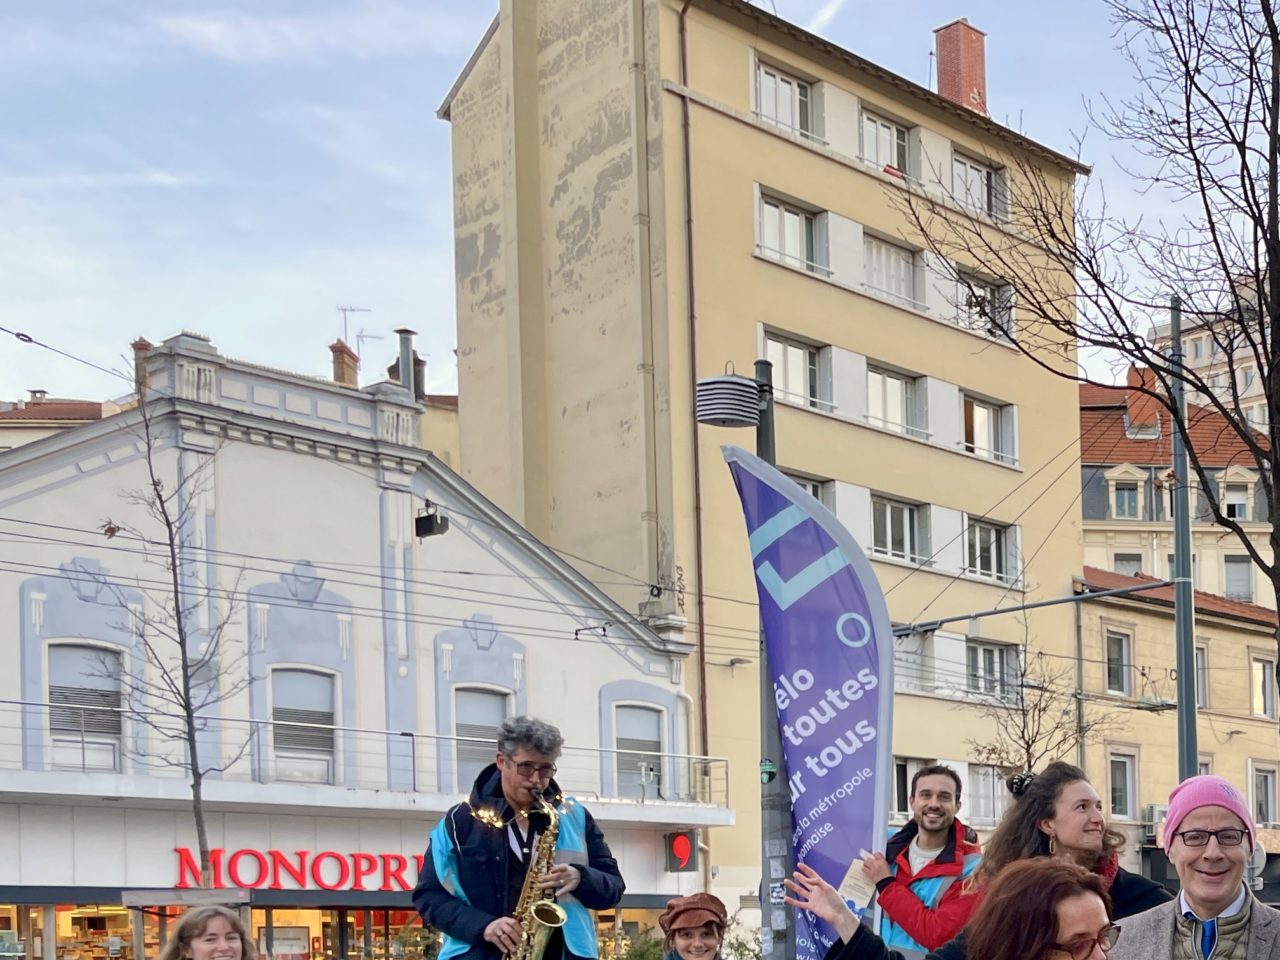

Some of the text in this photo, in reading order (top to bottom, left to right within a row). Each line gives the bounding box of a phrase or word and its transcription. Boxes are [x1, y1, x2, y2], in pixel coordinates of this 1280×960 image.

[774, 668, 814, 710] élo
[784, 667, 878, 746] toutes
[805, 719, 876, 777] tous
[799, 817, 810, 830] la
[809, 766, 873, 824] métropole
